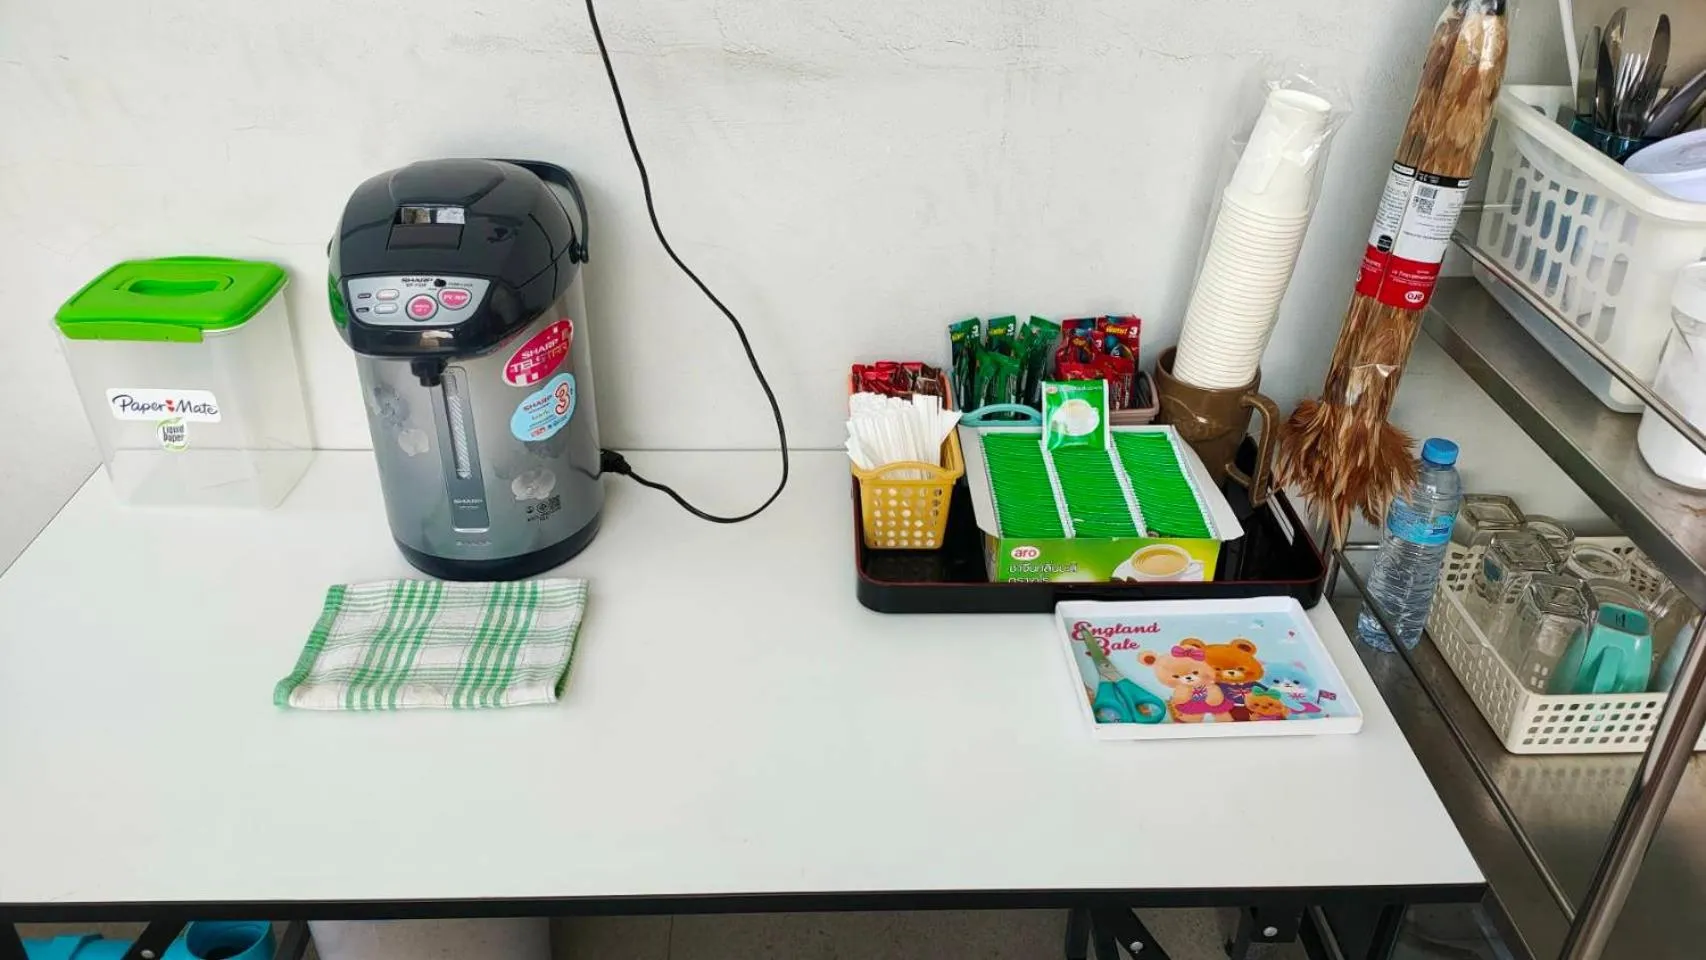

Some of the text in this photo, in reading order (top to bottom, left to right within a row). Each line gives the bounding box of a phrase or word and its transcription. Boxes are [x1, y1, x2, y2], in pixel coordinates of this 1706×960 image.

[1129, 326, 1138, 334] 3
[521, 338, 559, 359] SHARP
[112, 394, 218, 415] Paper Mate
[523, 394, 553, 411] SHARP
[554, 382, 571, 415] 3
[162, 424, 185, 434] Liquid
[163, 434, 185, 443] Paper
[1014, 549, 1037, 557] aro
[1071, 621, 1161, 641] England
